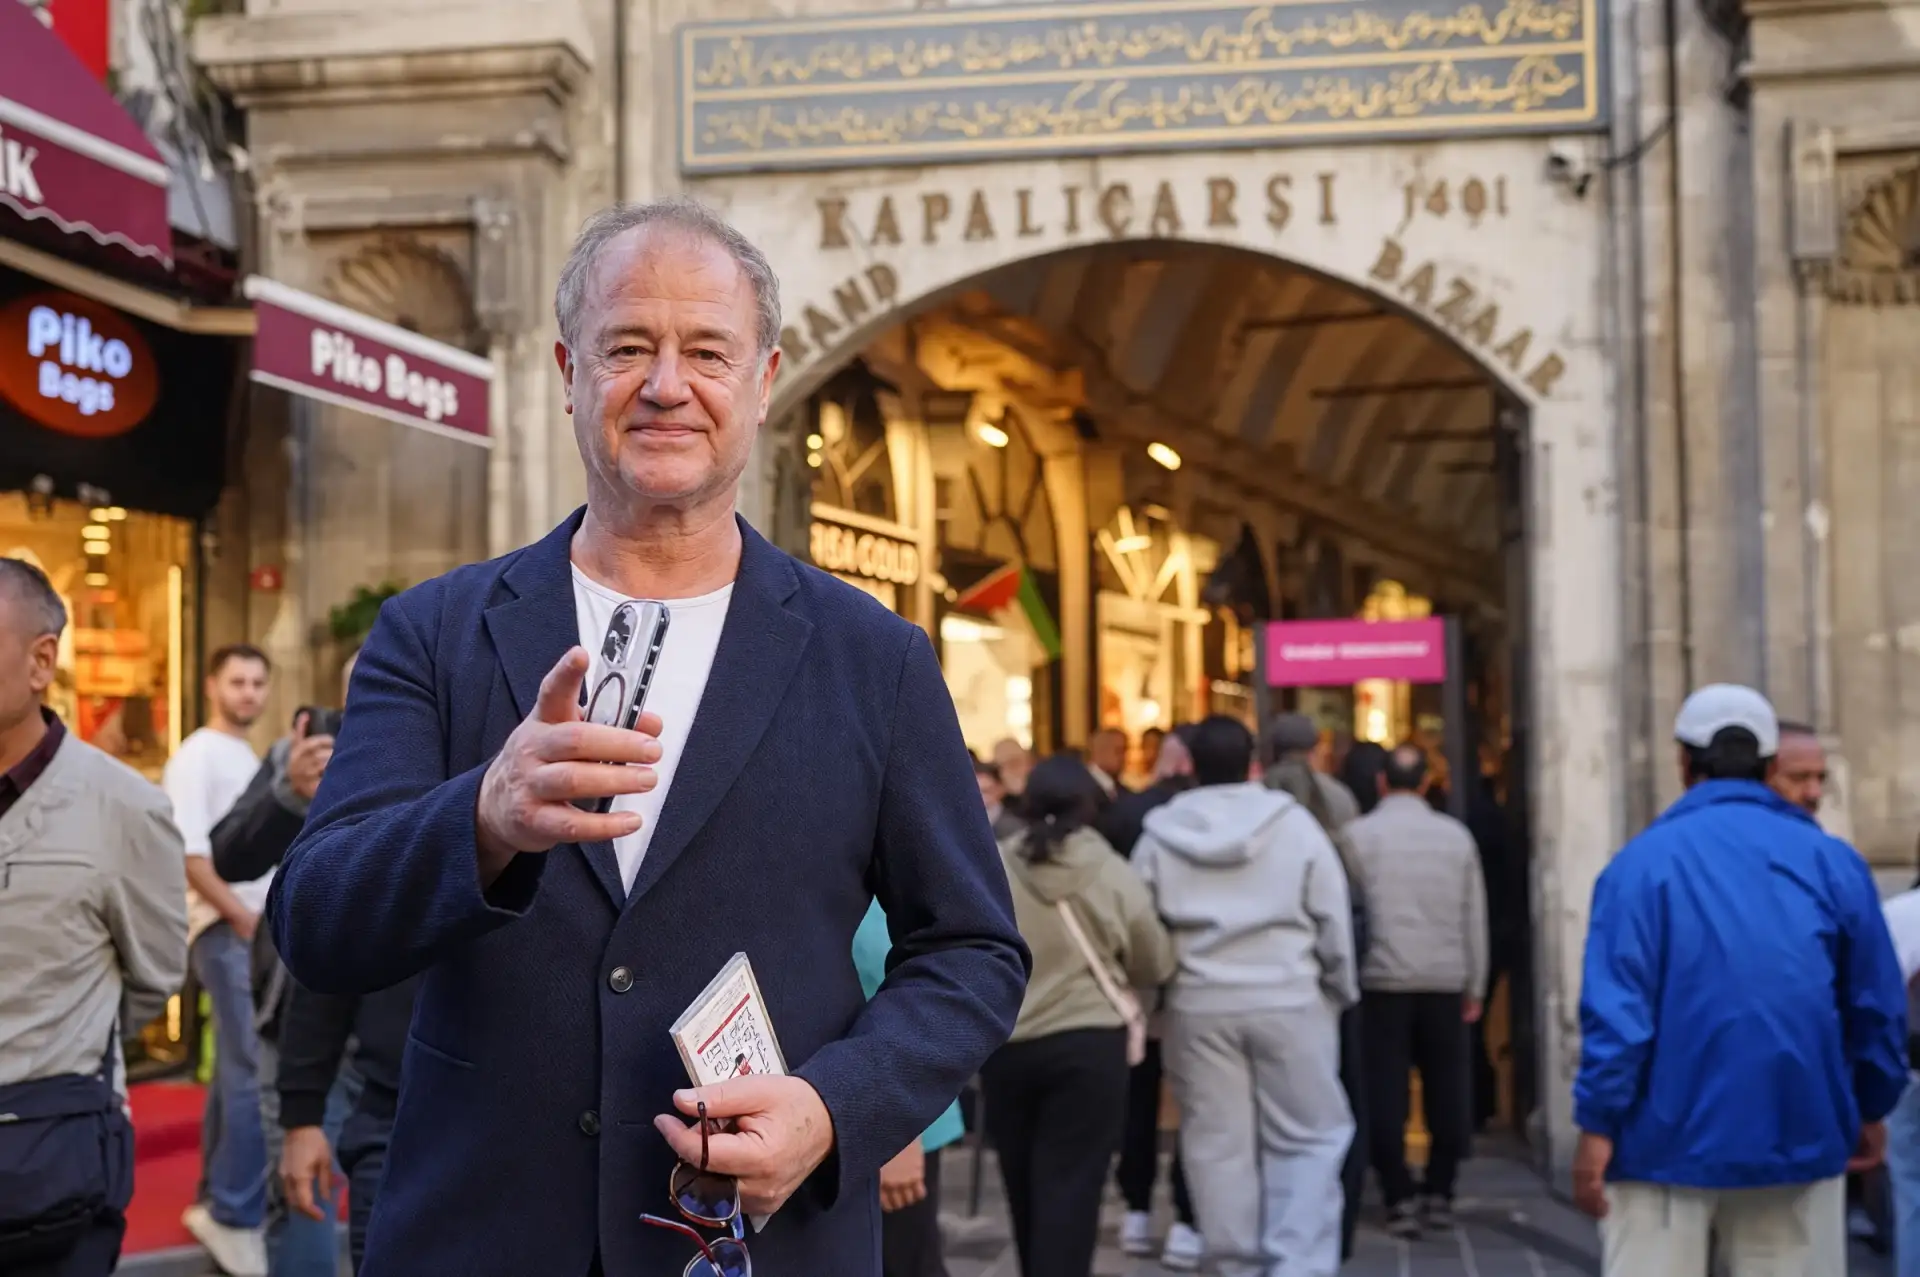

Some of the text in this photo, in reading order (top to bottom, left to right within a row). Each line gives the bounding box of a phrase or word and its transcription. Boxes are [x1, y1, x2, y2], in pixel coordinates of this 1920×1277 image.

[28, 305, 132, 378] Piko
[777, 234, 1566, 398] RAND BAZAAR
[38, 360, 115, 416] Bags
[311, 327, 458, 421] Piko Bags
